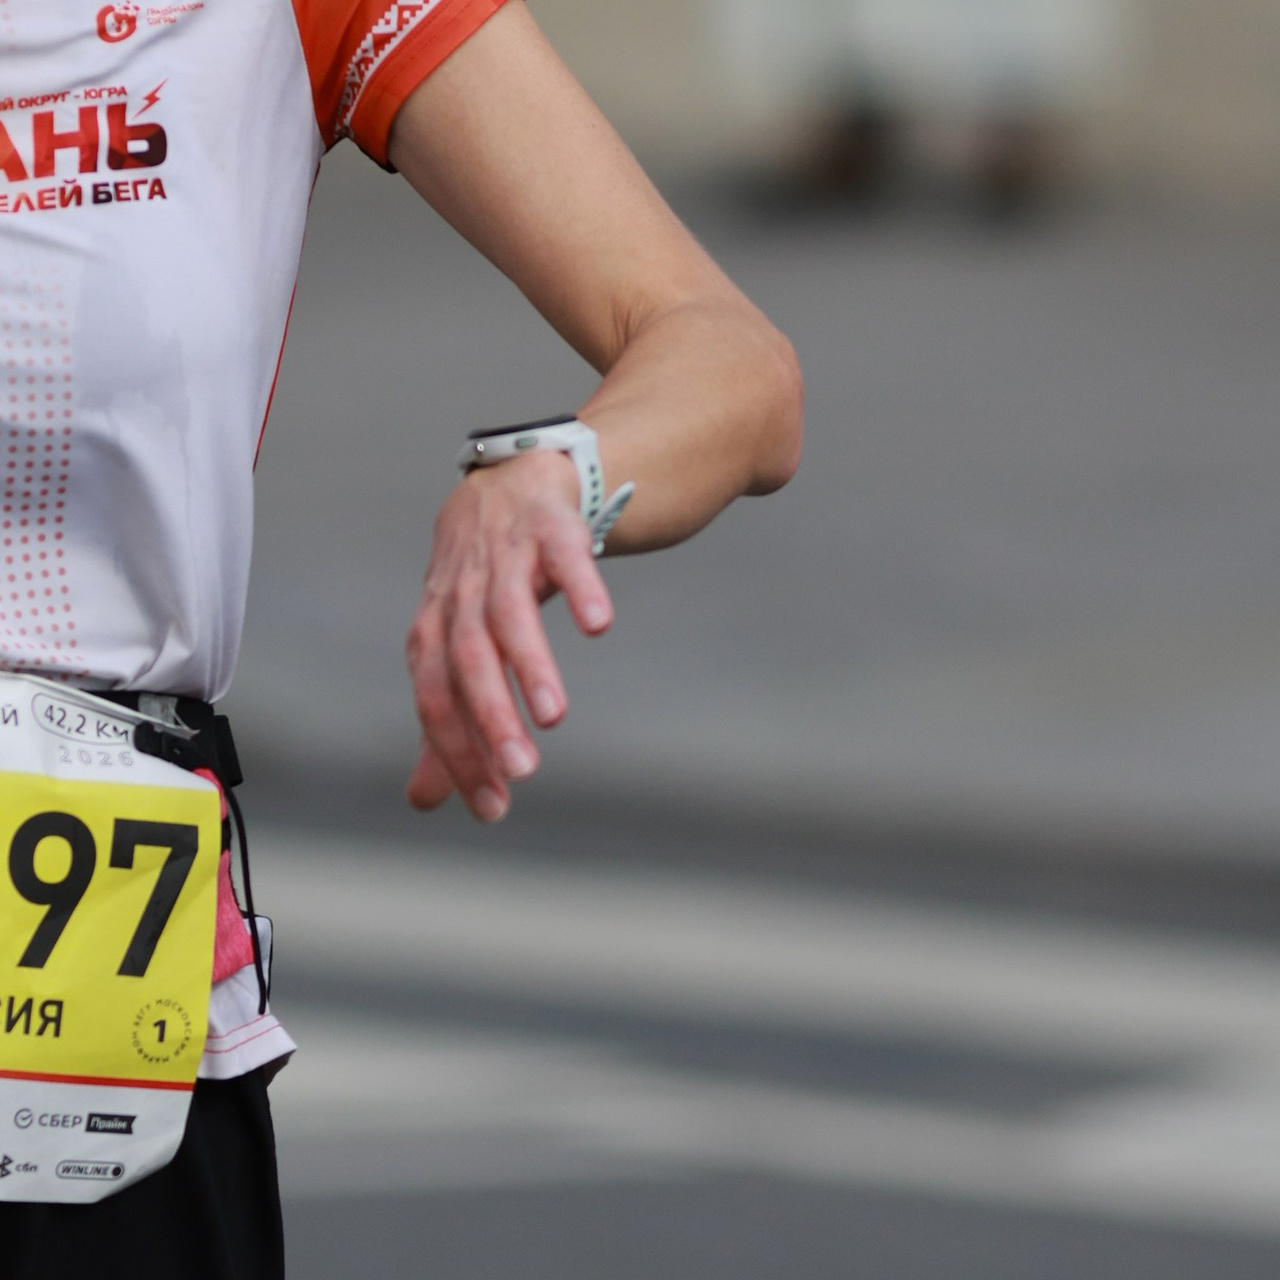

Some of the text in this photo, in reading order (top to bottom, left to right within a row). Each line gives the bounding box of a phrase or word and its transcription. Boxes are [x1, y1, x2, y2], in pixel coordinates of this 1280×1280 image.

[18, 90, 71, 109] ОКРУГ
[83, 86, 128, 100] ЮГРА
[92, 176, 168, 206] БЕГА
[44, 704, 87, 736] 42,2
[153, 1019, 167, 1043] 1
[37, 1112, 83, 1129] СБЕР
[60, 1164, 111, 1176] WINLINE
